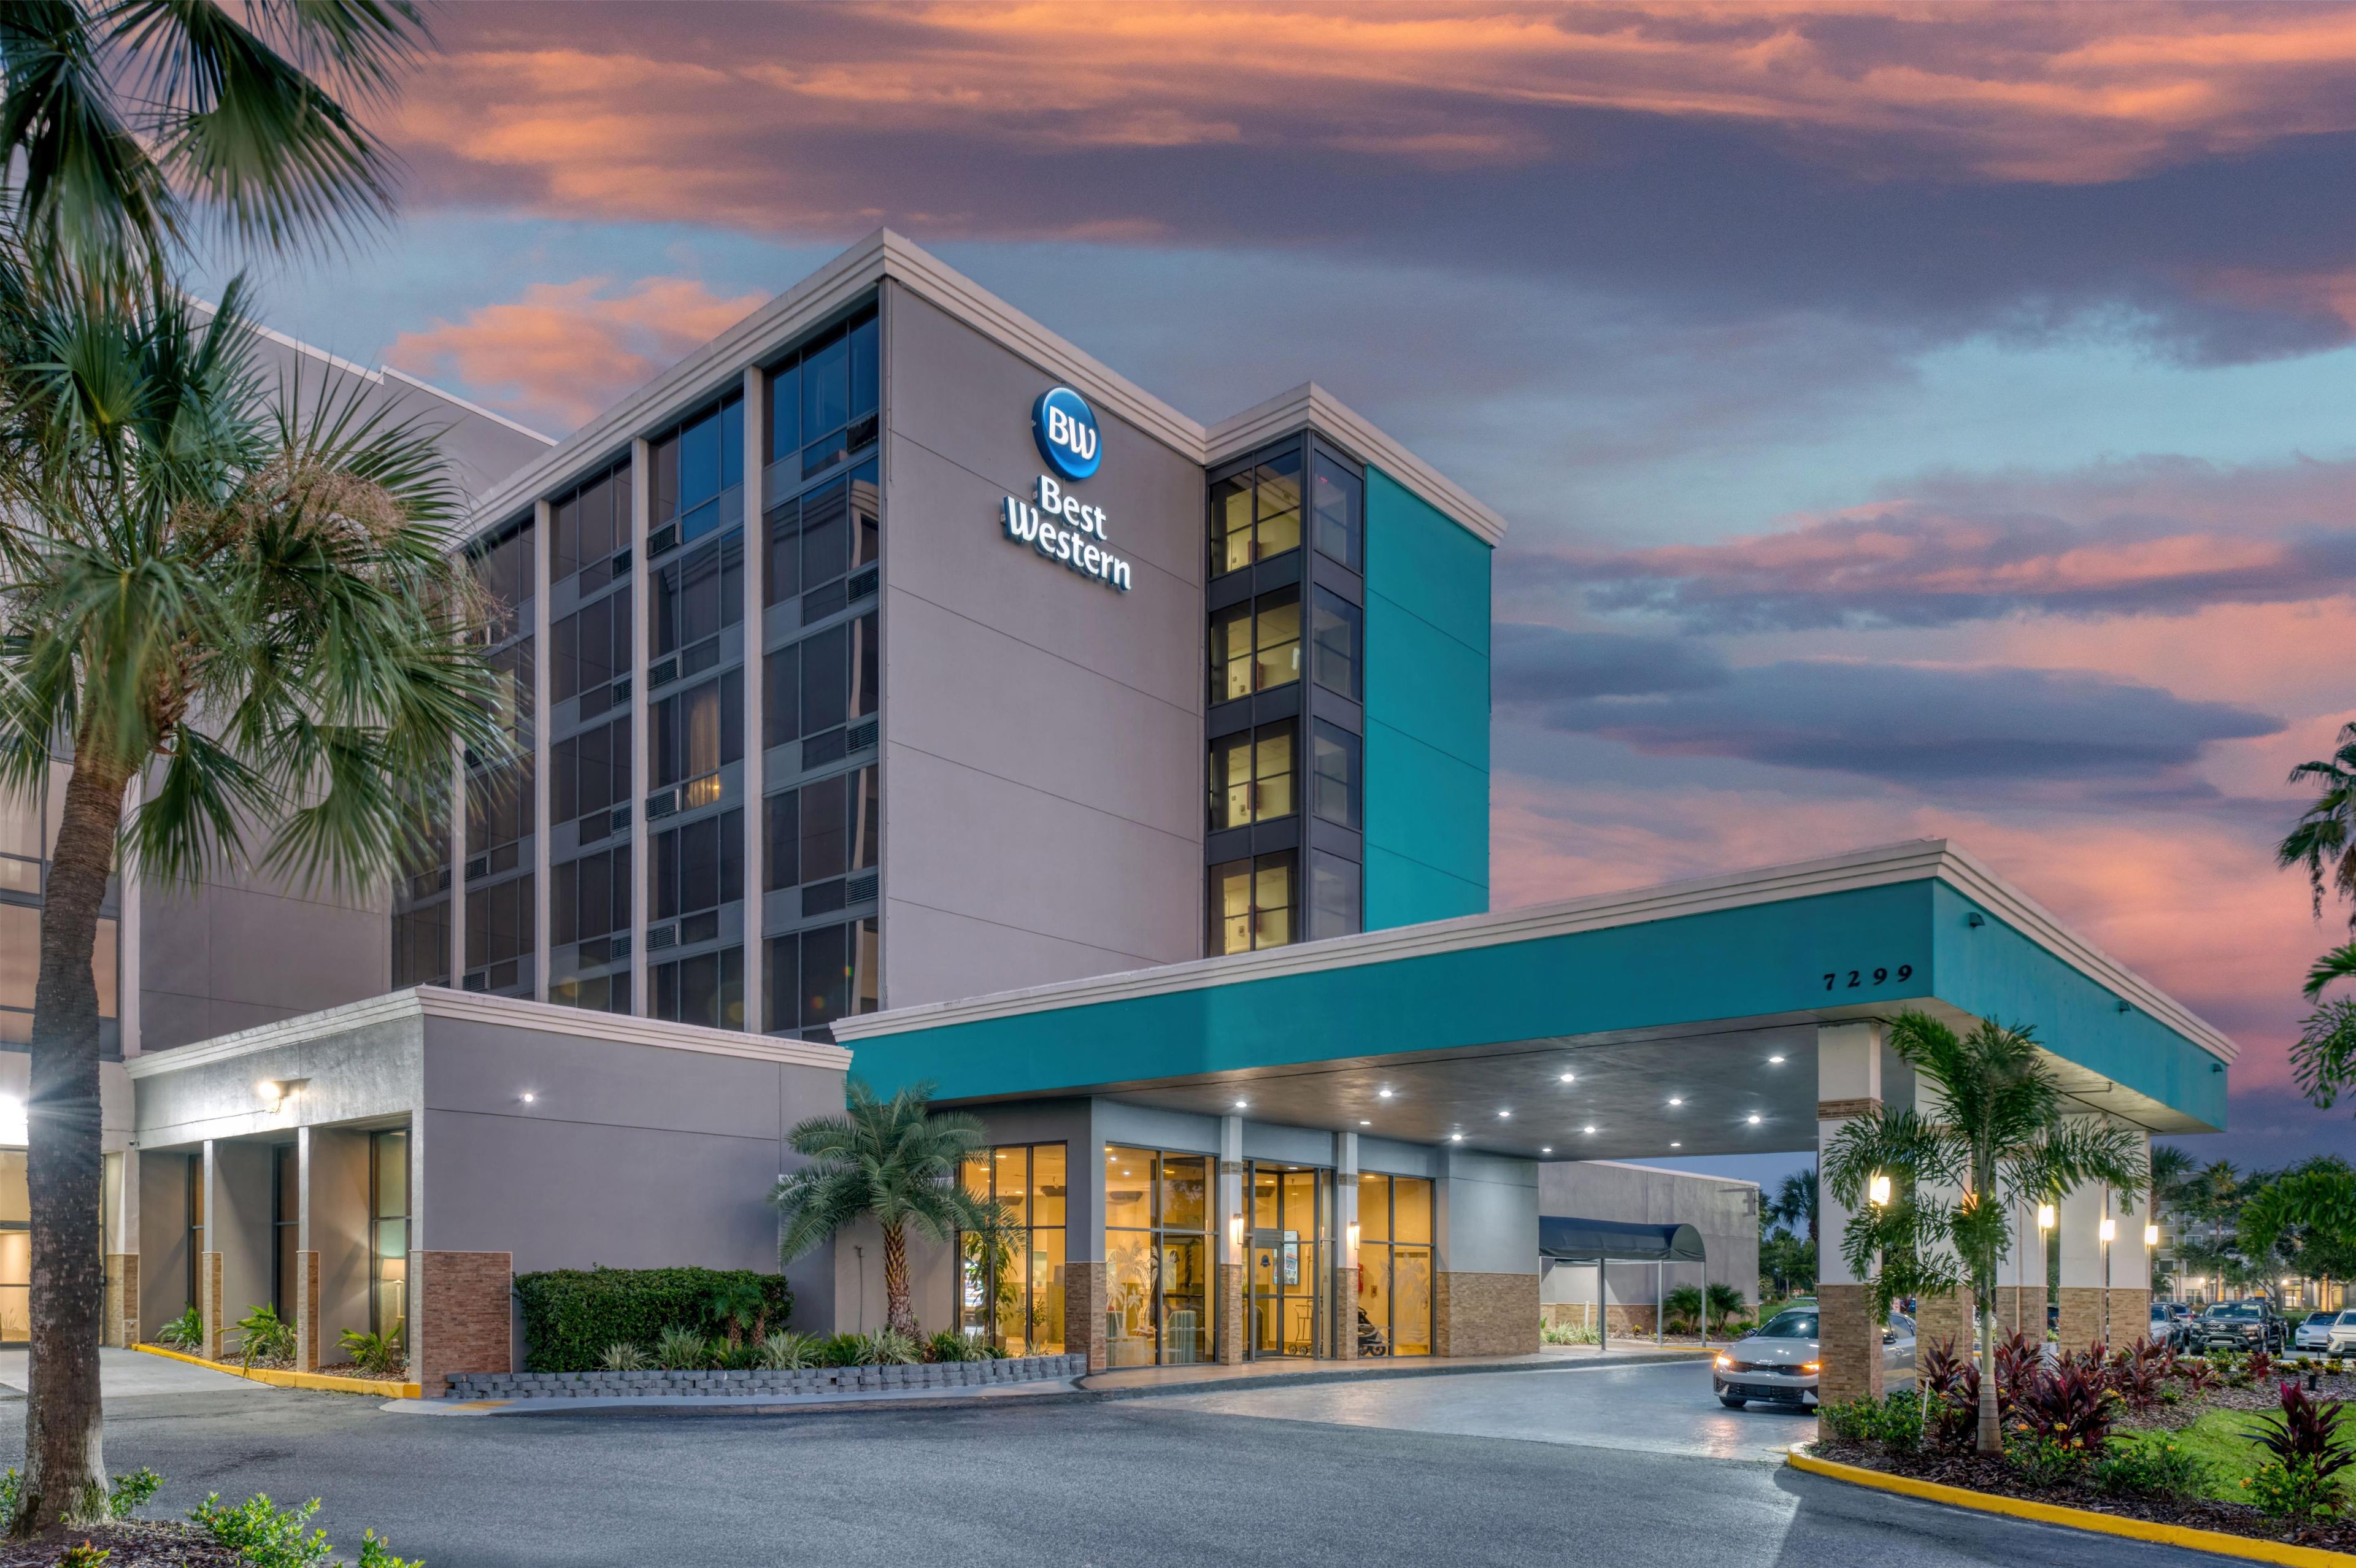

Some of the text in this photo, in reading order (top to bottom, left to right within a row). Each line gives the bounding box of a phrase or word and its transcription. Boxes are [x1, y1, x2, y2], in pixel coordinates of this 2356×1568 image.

[1049, 405, 1096, 460] BW
[1038, 475, 1107, 541] Best
[1004, 496, 1131, 590] Western
[1823, 964, 1912, 991] 7299
